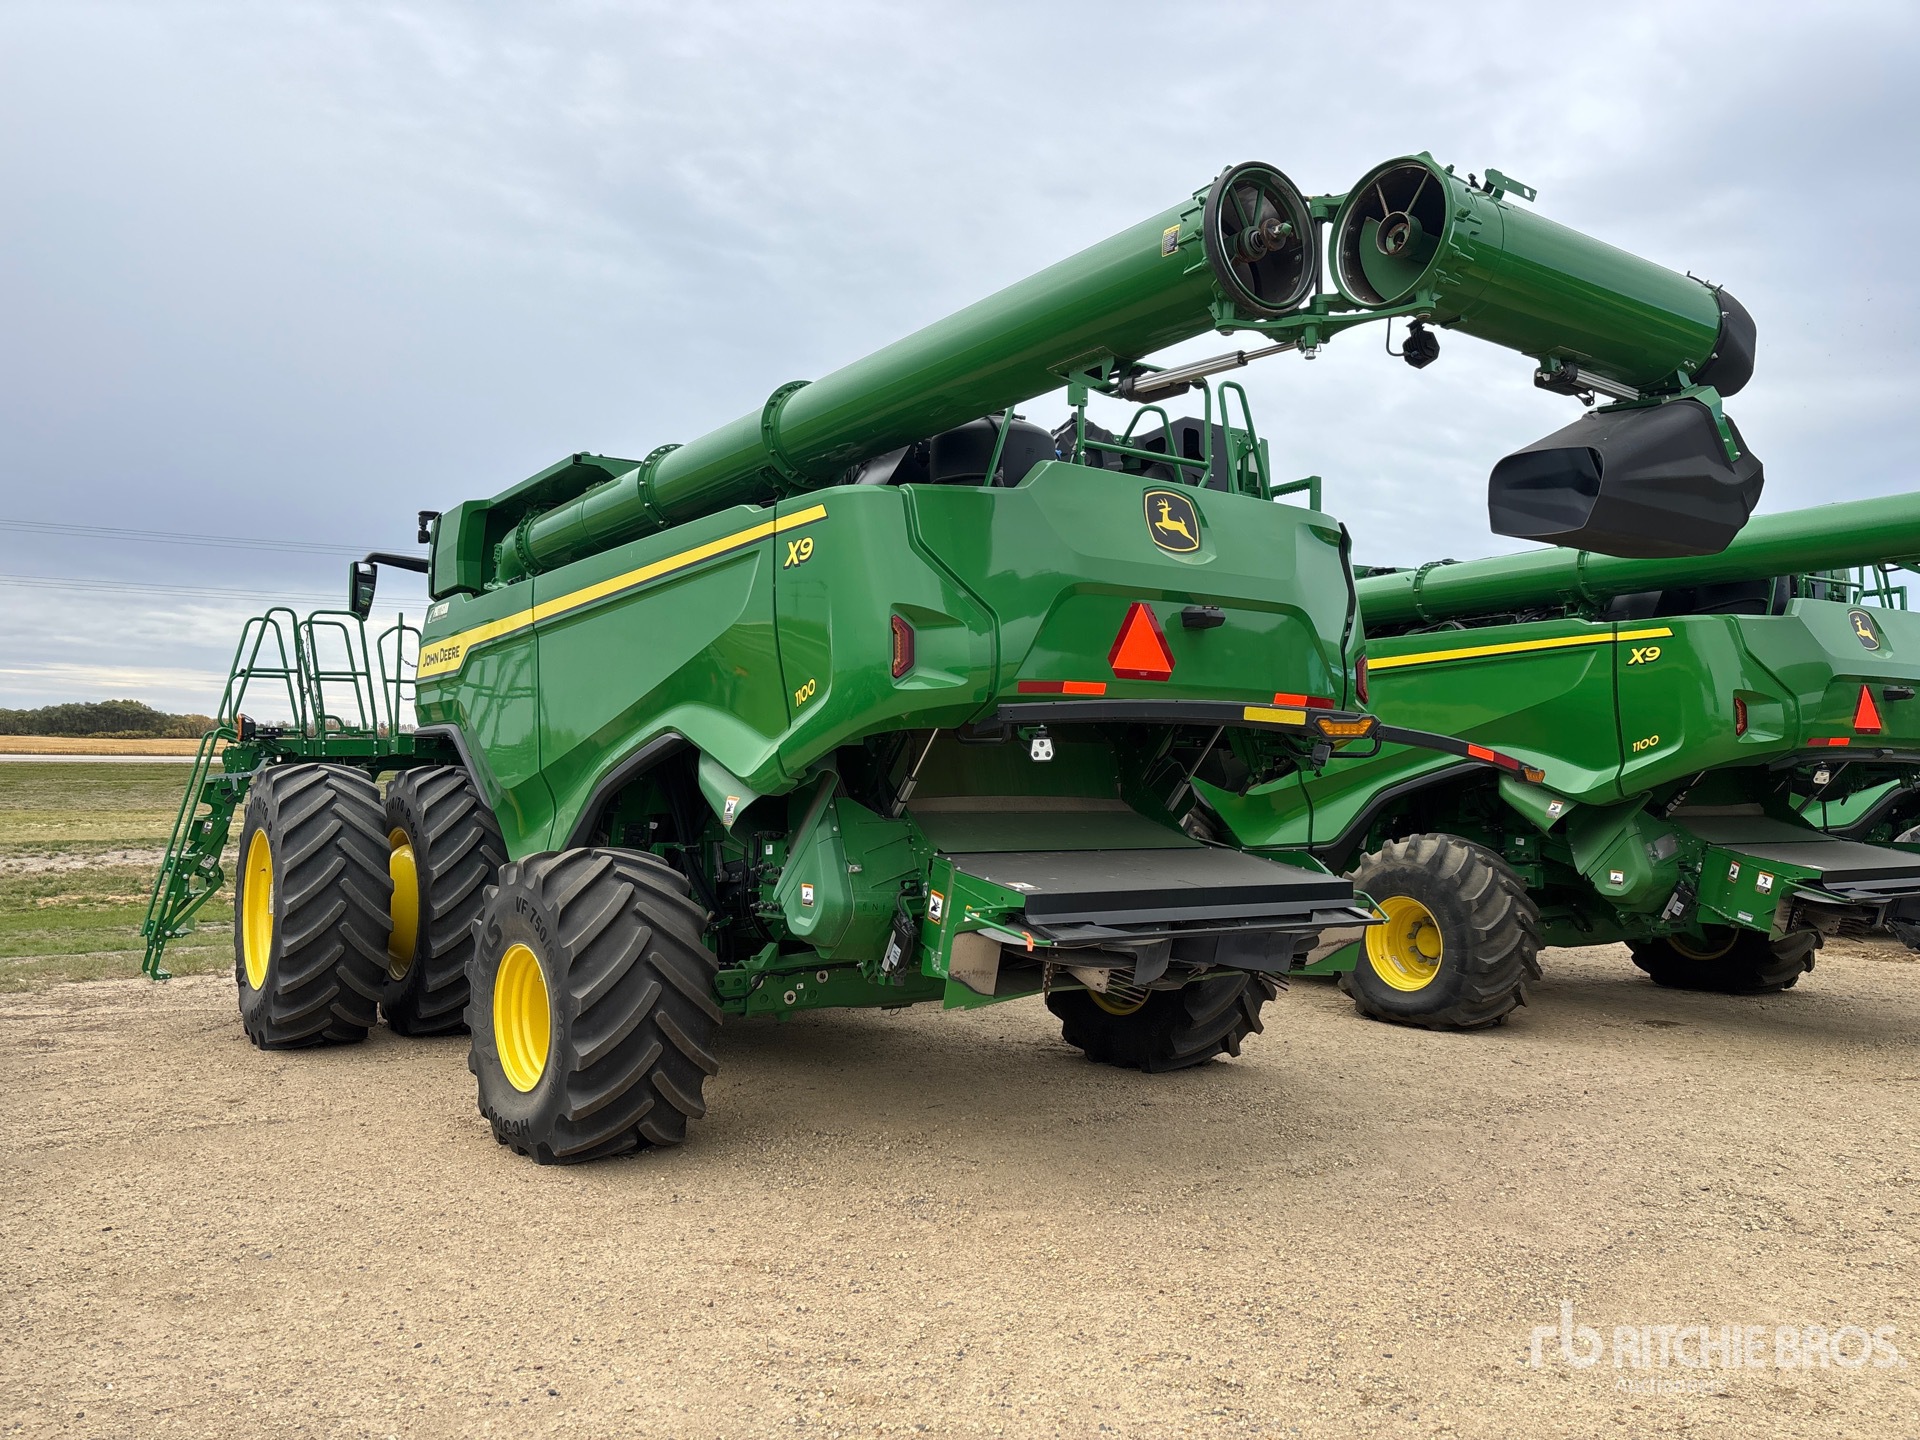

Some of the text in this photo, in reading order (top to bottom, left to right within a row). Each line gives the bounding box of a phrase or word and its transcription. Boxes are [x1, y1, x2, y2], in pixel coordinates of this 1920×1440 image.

[783, 536, 815, 570] X9
[423, 645, 461, 667] JOHN DEERE
[1627, 646, 1661, 666] X9
[795, 678, 816, 708] 1100
[1632, 735, 1659, 752] 1100
[515, 896, 529, 915] VF
